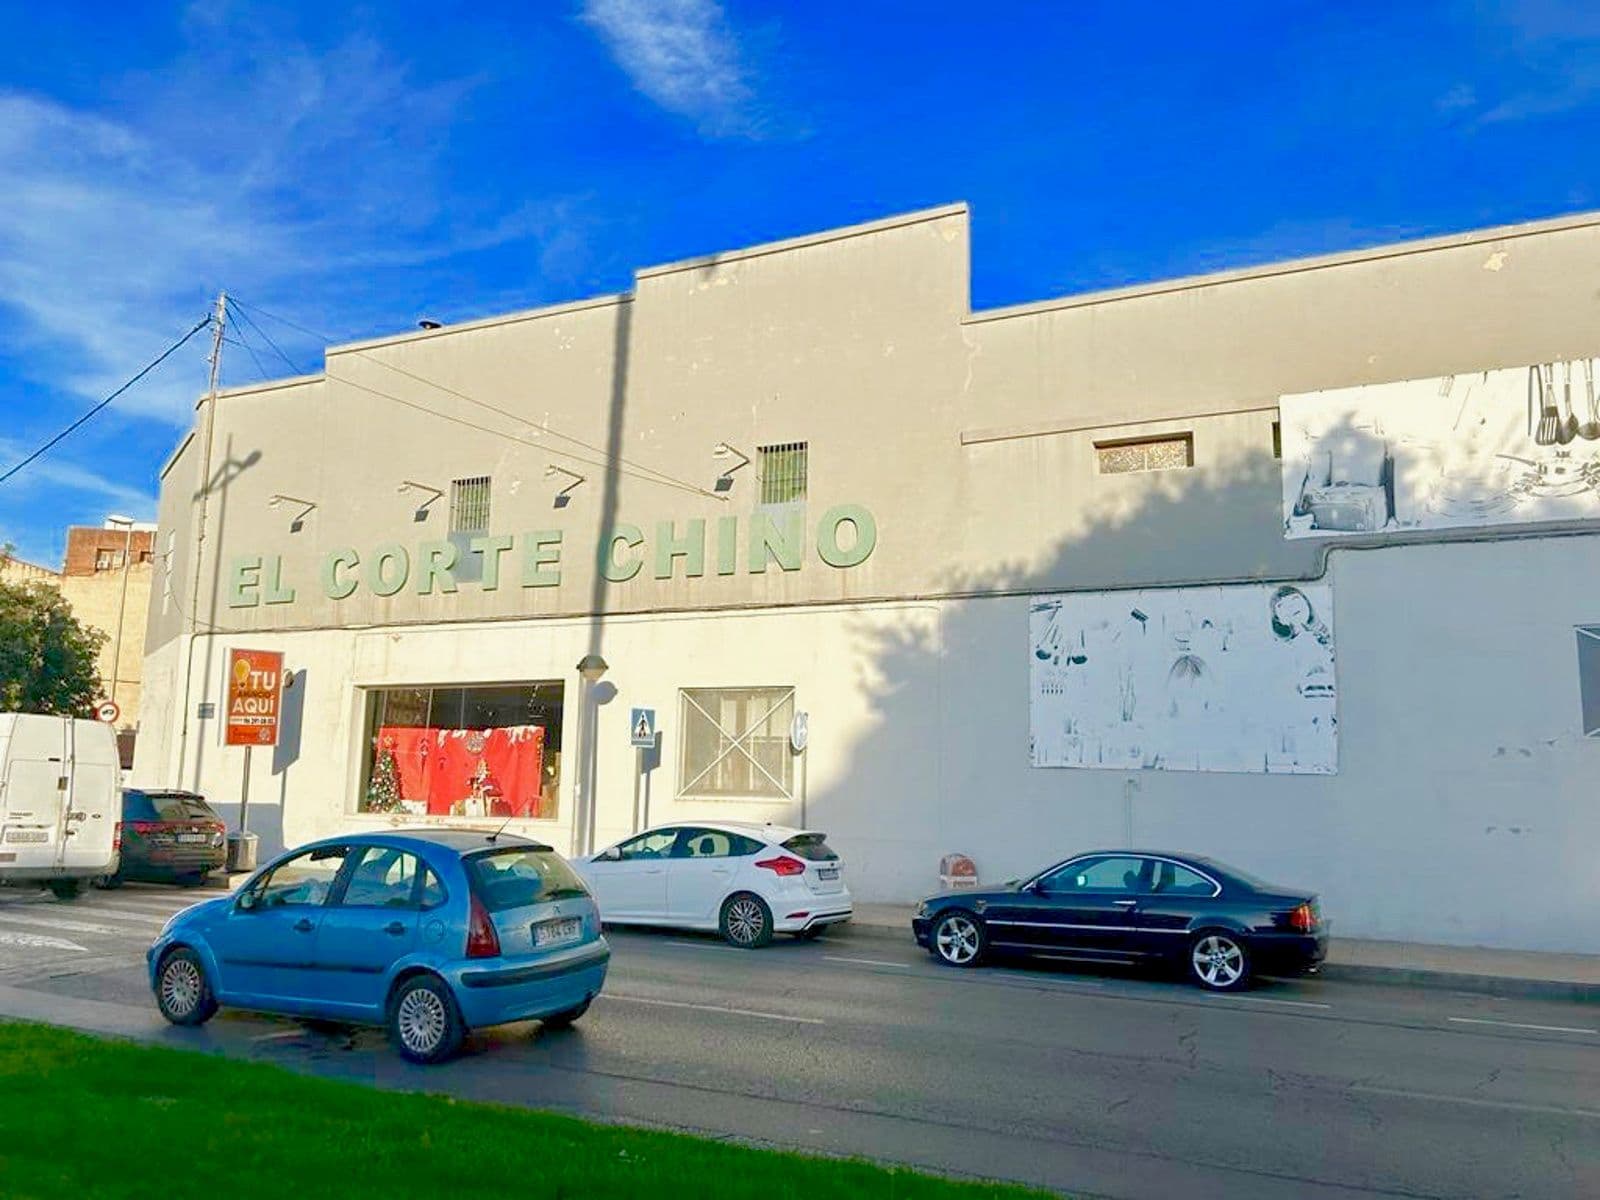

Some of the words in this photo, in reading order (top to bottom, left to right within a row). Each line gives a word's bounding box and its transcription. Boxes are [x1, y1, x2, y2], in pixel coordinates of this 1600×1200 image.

[229, 553, 295, 609] EL
[321, 530, 563, 601] CORTE
[599, 503, 877, 583] CHINO
[250, 671, 276, 691] TU
[232, 694, 275, 714] AQUÍ
